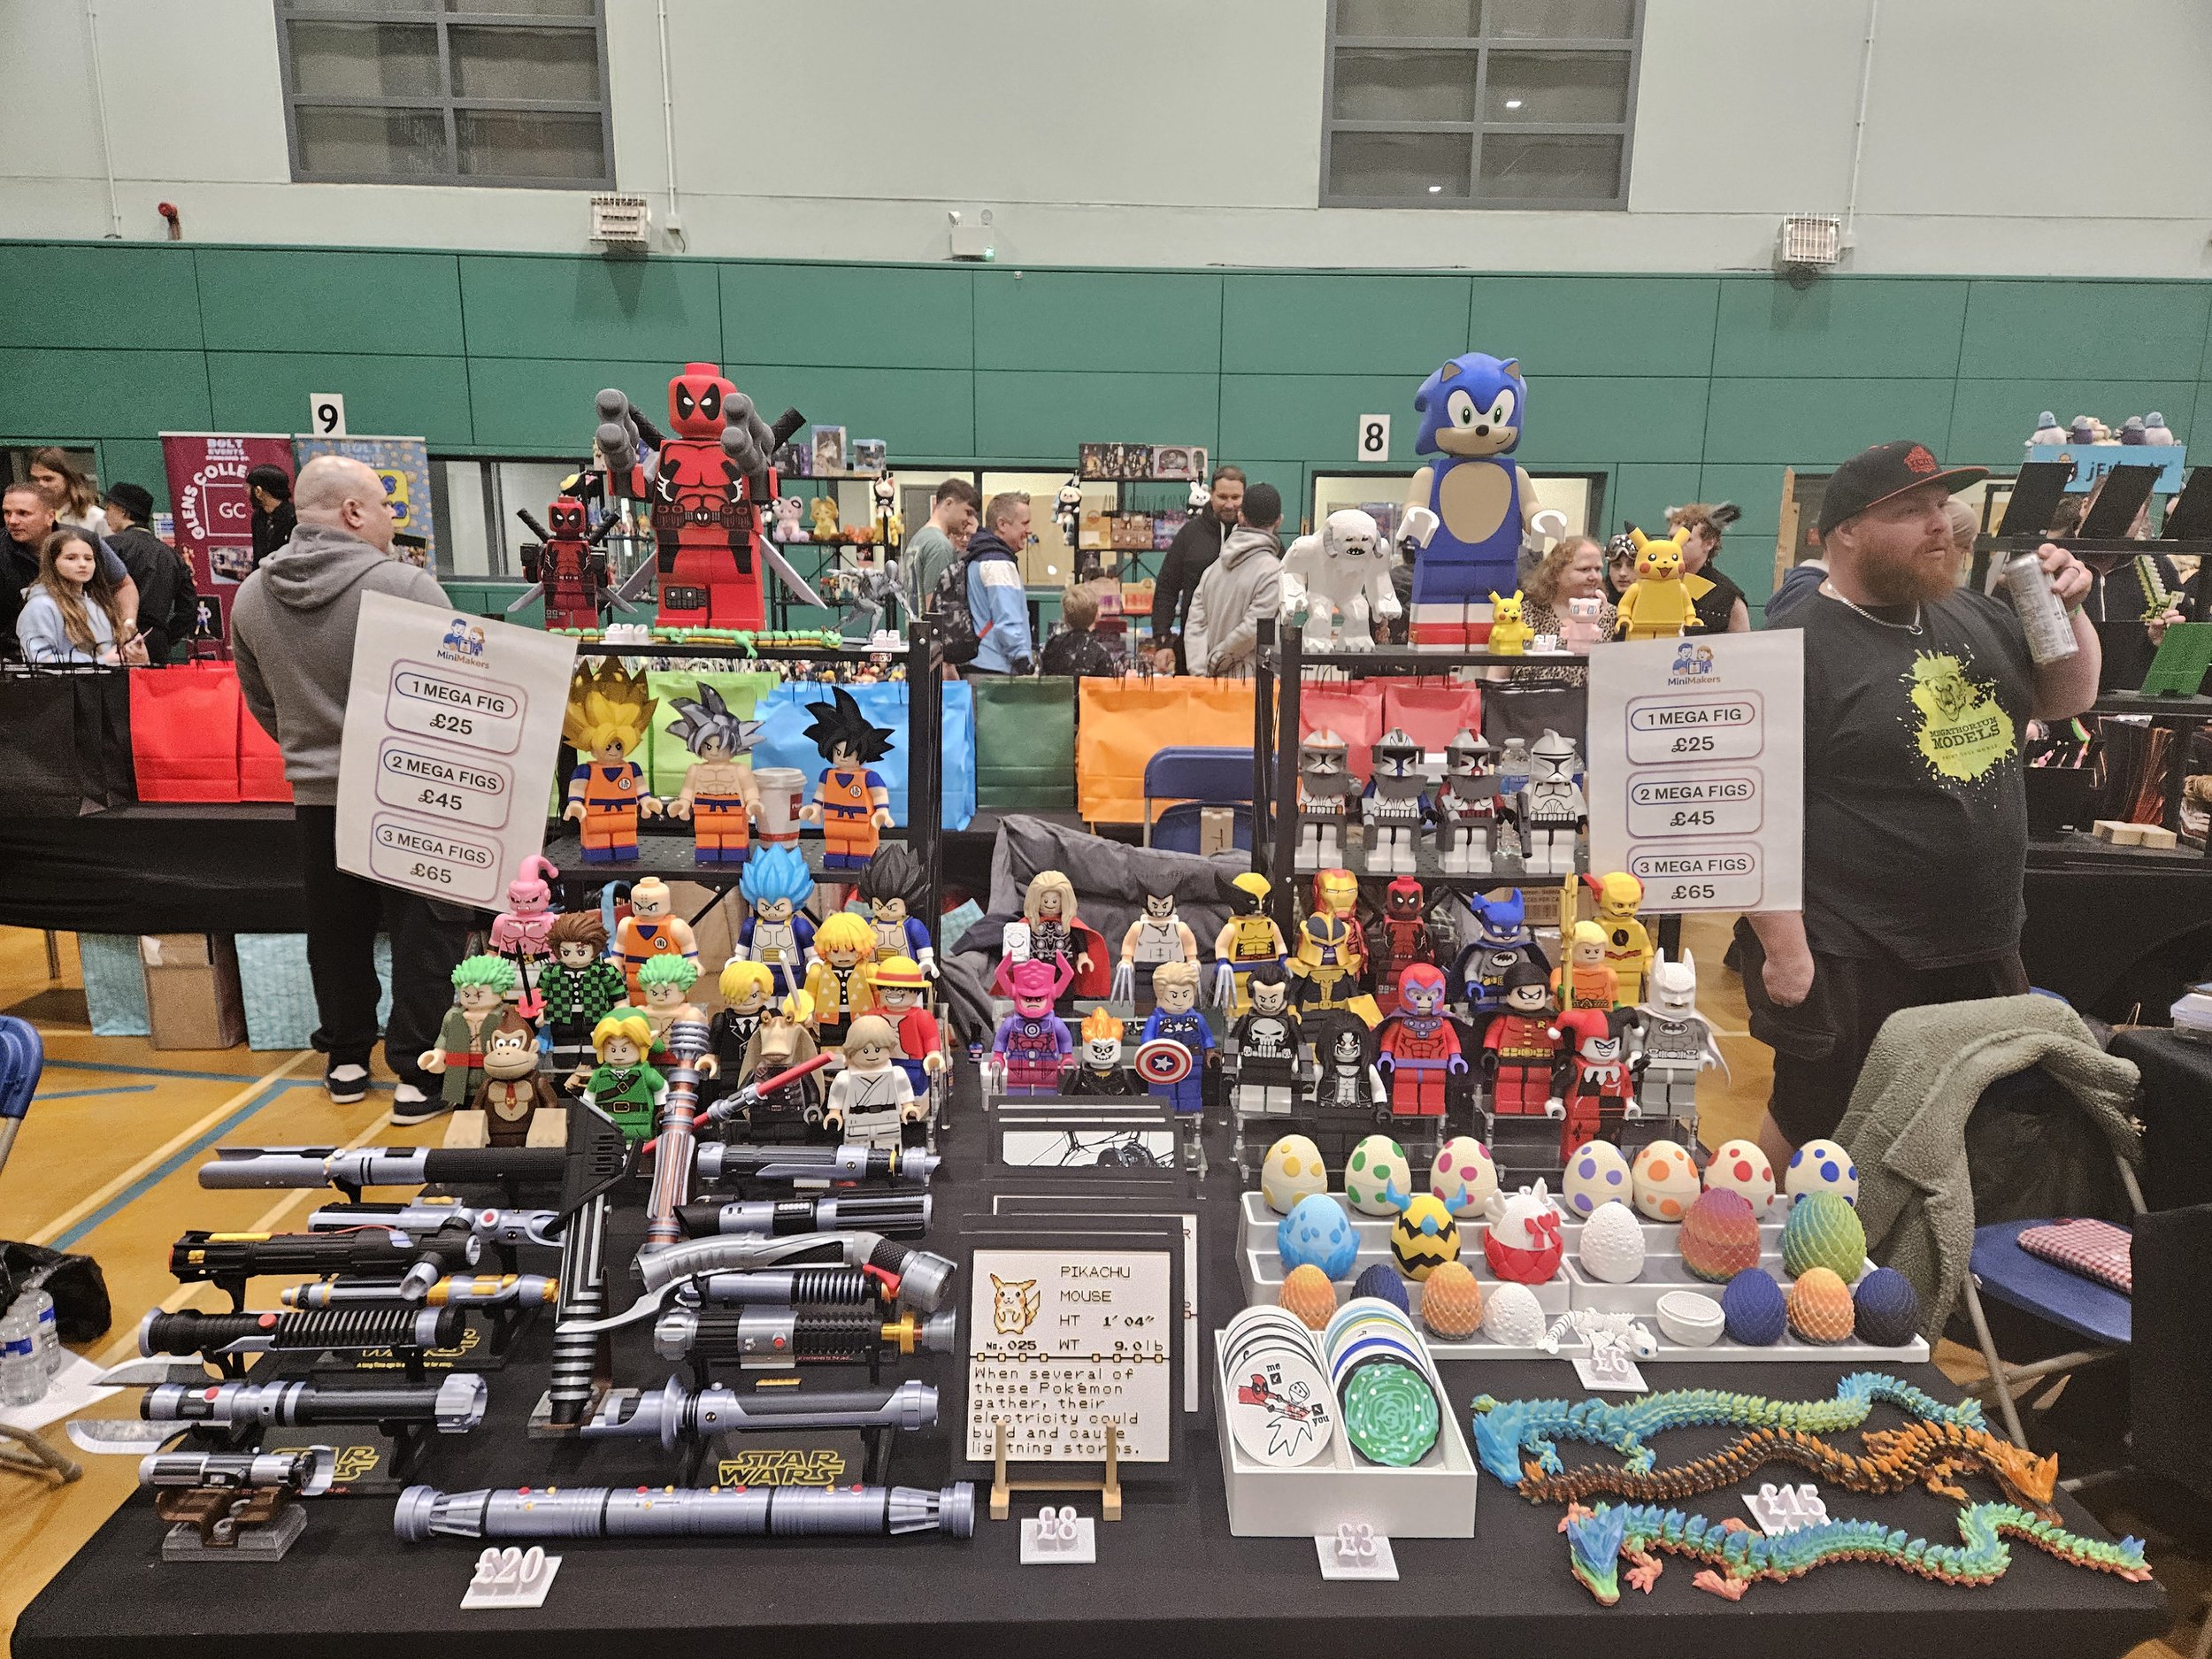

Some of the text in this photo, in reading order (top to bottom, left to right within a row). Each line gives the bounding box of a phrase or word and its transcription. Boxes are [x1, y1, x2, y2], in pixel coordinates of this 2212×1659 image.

[318, 403, 338, 434] 9
[1364, 422, 1384, 452] 8
[219, 503, 247, 519] GC
[436, 650, 490, 670] MiniMakers
[1667, 675, 1721, 687] MiniMakers
[412, 680, 505, 713] 1 MEGA FIG
[429, 713, 473, 735] £25
[1648, 709, 1742, 726] 1 MEGA FIG
[1671, 736, 1715, 753] £25
[1932, 723, 2001, 749] MODELS
[392, 756, 497, 790] 2 MEGA FIGS
[418, 789, 462, 810] £45
[1640, 784, 1747, 801] 2 MEGA FIGS
[1671, 810, 1715, 827] £45
[383, 830, 487, 864] 3 MEGA FIGS
[410, 863, 452, 883] £65
[1640, 858, 1747, 873] 3 MEGA FIGS
[1671, 885, 1716, 901] £65
[1061, 1266, 1131, 1279] PIKACHU
[1060, 1290, 1112, 1302] MOUSE
[1060, 1315, 1080, 1326] HT
[1059, 1339, 1080, 1351] WT
[1266, 1363, 1281, 1372] me
[1593, 1346, 1628, 1374] £6
[975, 1367, 1133, 1380] When several of
[975, 1382, 1122, 1394] these Pokémon
[974, 1396, 1105, 1410] gather, their
[973, 1411, 1138, 1425] electricity could
[1312, 1416, 1330, 1427] you
[973, 1425, 1125, 1439] bud and caue
[972, 1441, 1052, 1455] ligtning
[718, 1450, 846, 1469] STAR
[718, 1467, 845, 1486] WARS
[1761, 1482, 1827, 1517] £15
[1036, 1506, 1078, 1540] £8
[1337, 1522, 1377, 1557] £3
[470, 1546, 545, 1584] £20
